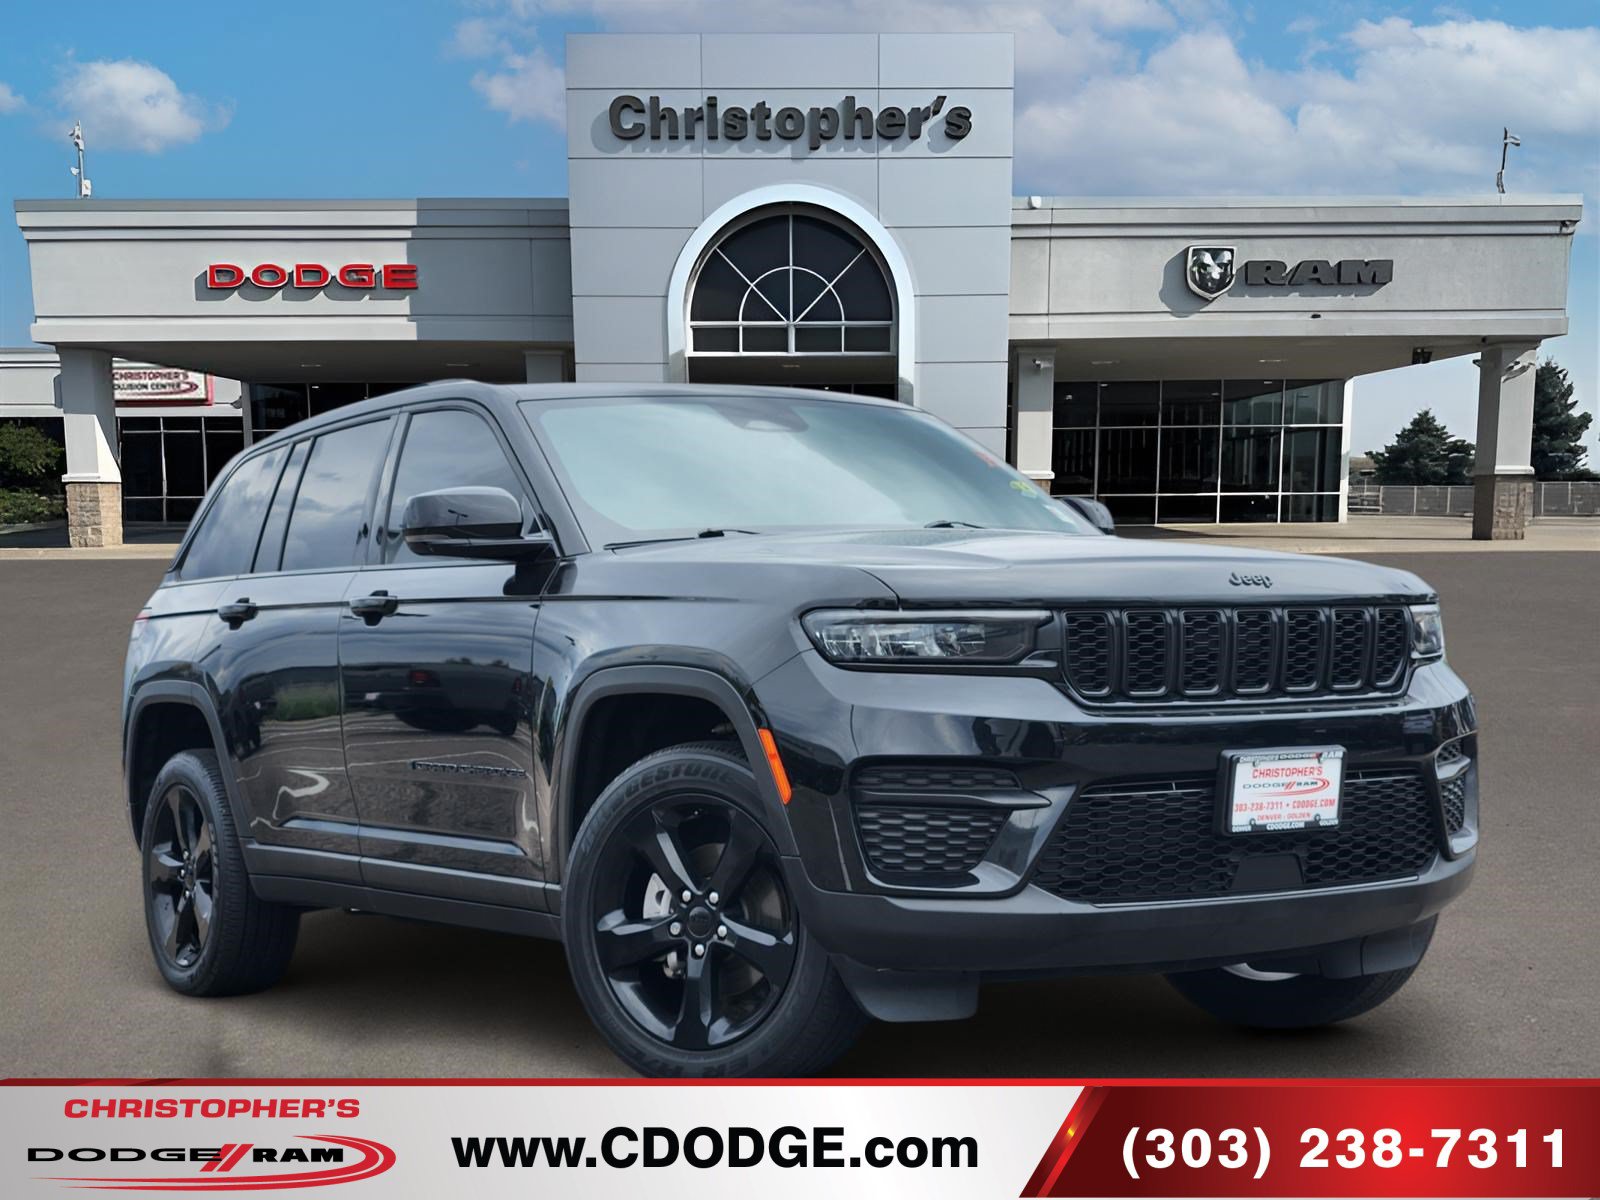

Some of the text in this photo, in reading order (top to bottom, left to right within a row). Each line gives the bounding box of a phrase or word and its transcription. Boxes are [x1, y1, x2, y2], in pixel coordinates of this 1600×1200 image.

[609, 95, 972, 150] Christopher's
[207, 263, 419, 289] DODGE
[1245, 259, 1394, 286] RAM
[113, 383, 148, 391] OLLISION
[1228, 572, 1272, 589] Jeep
[1252, 766, 1323, 779] CHRISTOPHER'S
[1234, 801, 1283, 813] 303-238-7311
